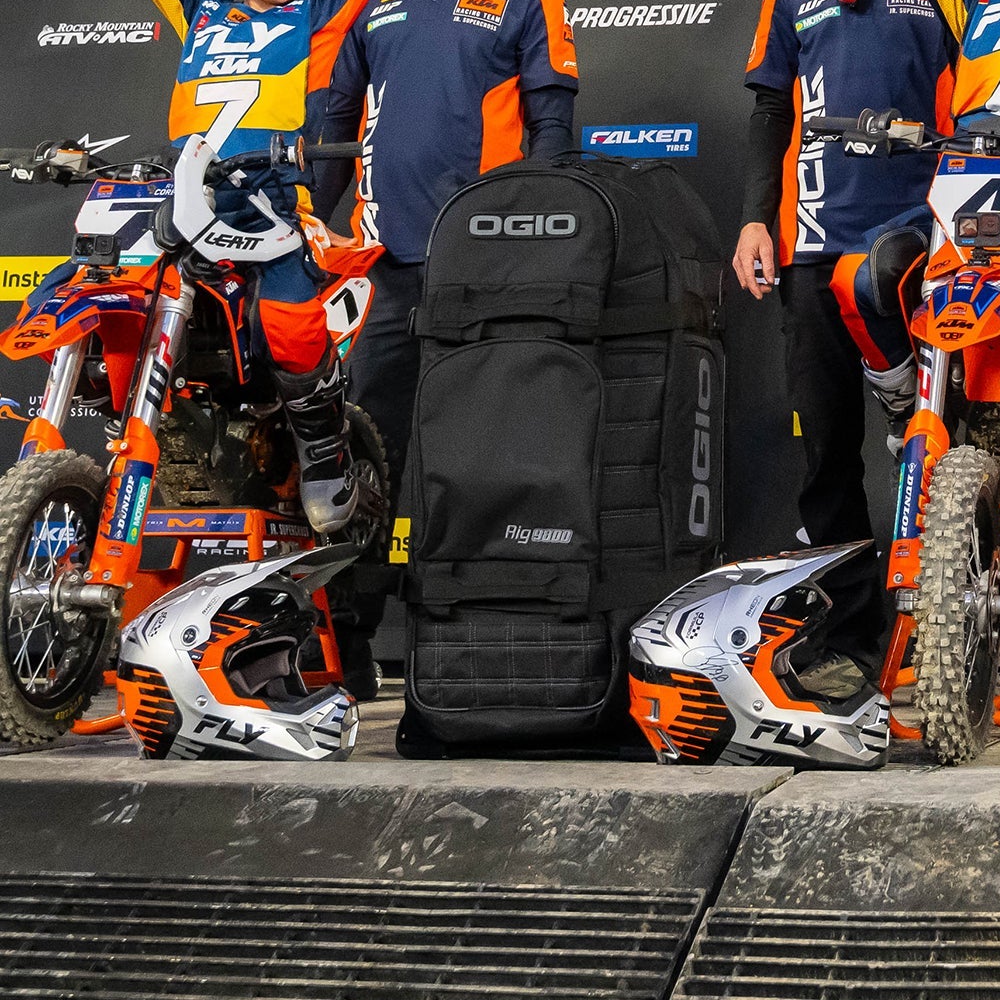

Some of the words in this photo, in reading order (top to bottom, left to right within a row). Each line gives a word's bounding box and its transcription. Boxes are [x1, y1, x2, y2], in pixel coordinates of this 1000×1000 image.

[370, 0, 402, 17] WP
[456, 8, 480, 17] RACING
[482, 12, 501, 23] TEAM
[570, 2, 718, 28] PROGRESSIVE
[802, 7, 839, 29] MOTOREX
[900, 7, 935, 17] SUPERCROSS
[57, 23, 92, 32] ROCKY
[95, 22, 154, 31] MOUNTAIN
[373, 13, 406, 29] MOTOREX
[463, 17, 497, 31] SUPERCROSS
[183, 22, 296, 63] FLY
[200, 55, 261, 77] KTM
[195, 80, 261, 154] 7
[590, 128, 693, 145] FALKEN
[666, 144, 690, 152] TIRES
[844, 141, 877, 154] ASV
[468, 214, 576, 236] OGIO
[204, 231, 264, 250] LEATT
[225, 280, 239, 296] KTM
[330, 287, 360, 326] 7
[935, 319, 975, 330] KTM
[688, 358, 711, 537] OGIO
[117, 475, 136, 530] DUNLOP
[132, 483, 149, 526] MOTOREX
[901, 475, 914, 537] DUNLOP
[695, 611, 705, 626] CP
[193, 713, 270, 745] FLY
[750, 718, 826, 748] FLY
